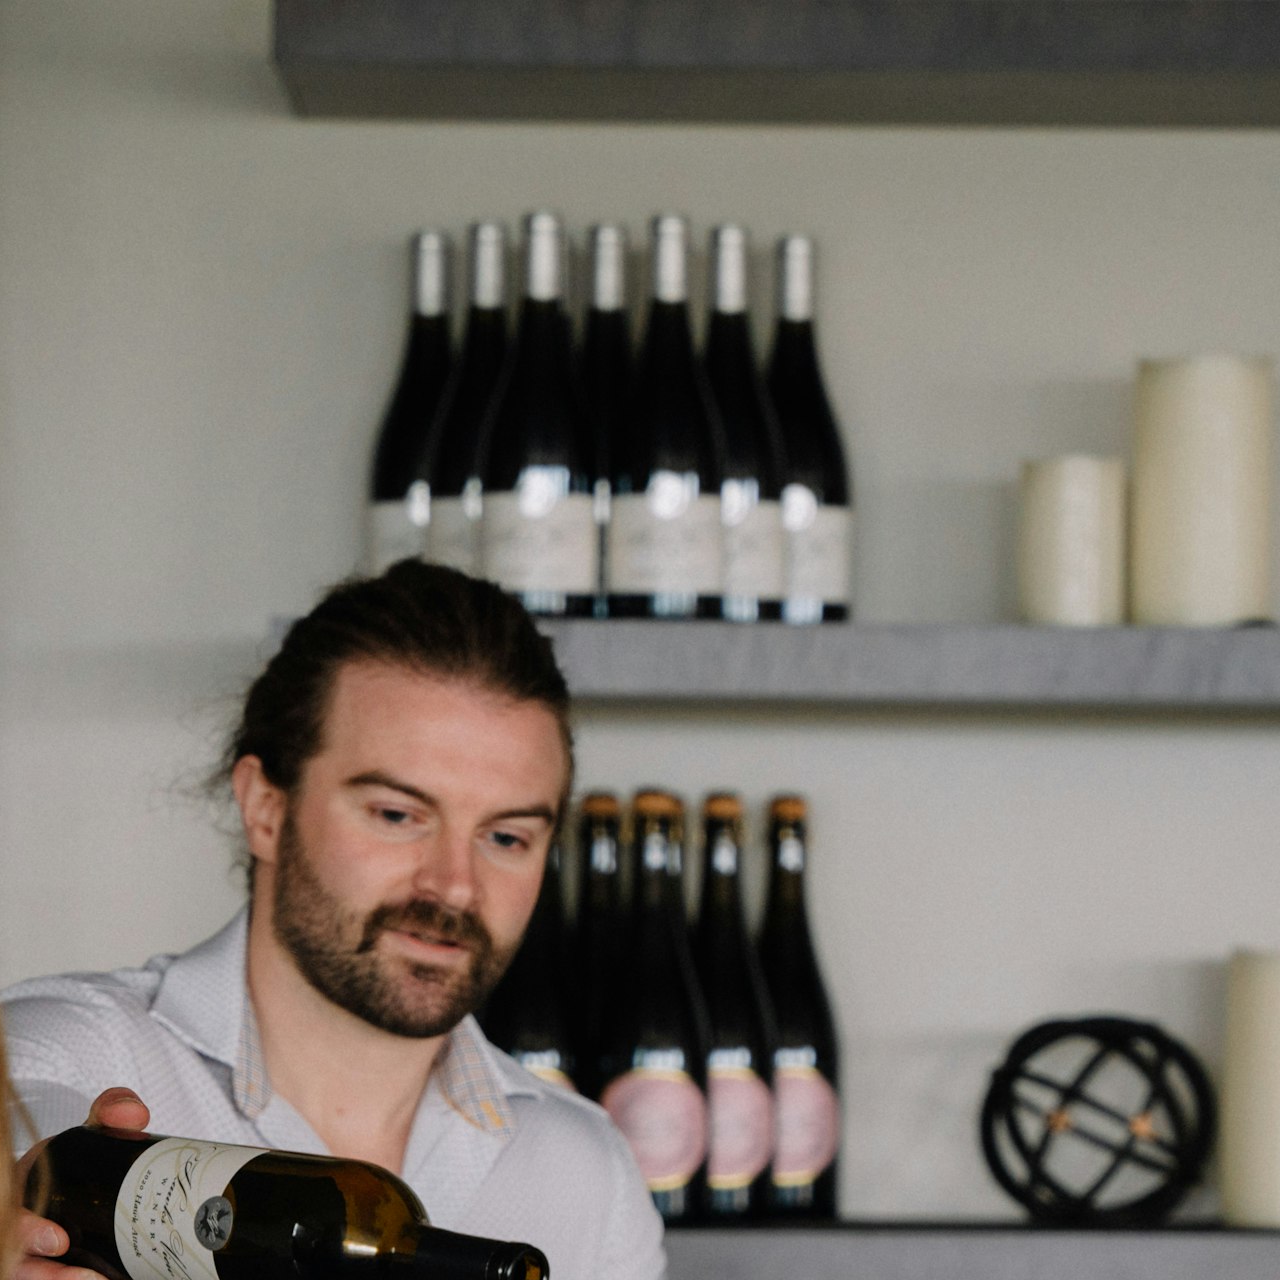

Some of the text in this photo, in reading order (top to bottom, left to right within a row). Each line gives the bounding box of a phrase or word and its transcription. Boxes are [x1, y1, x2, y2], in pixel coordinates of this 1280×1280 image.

[131, 1169, 152, 1258] 2020 Hawk Attack
[149, 1177, 168, 1254] WINERY
